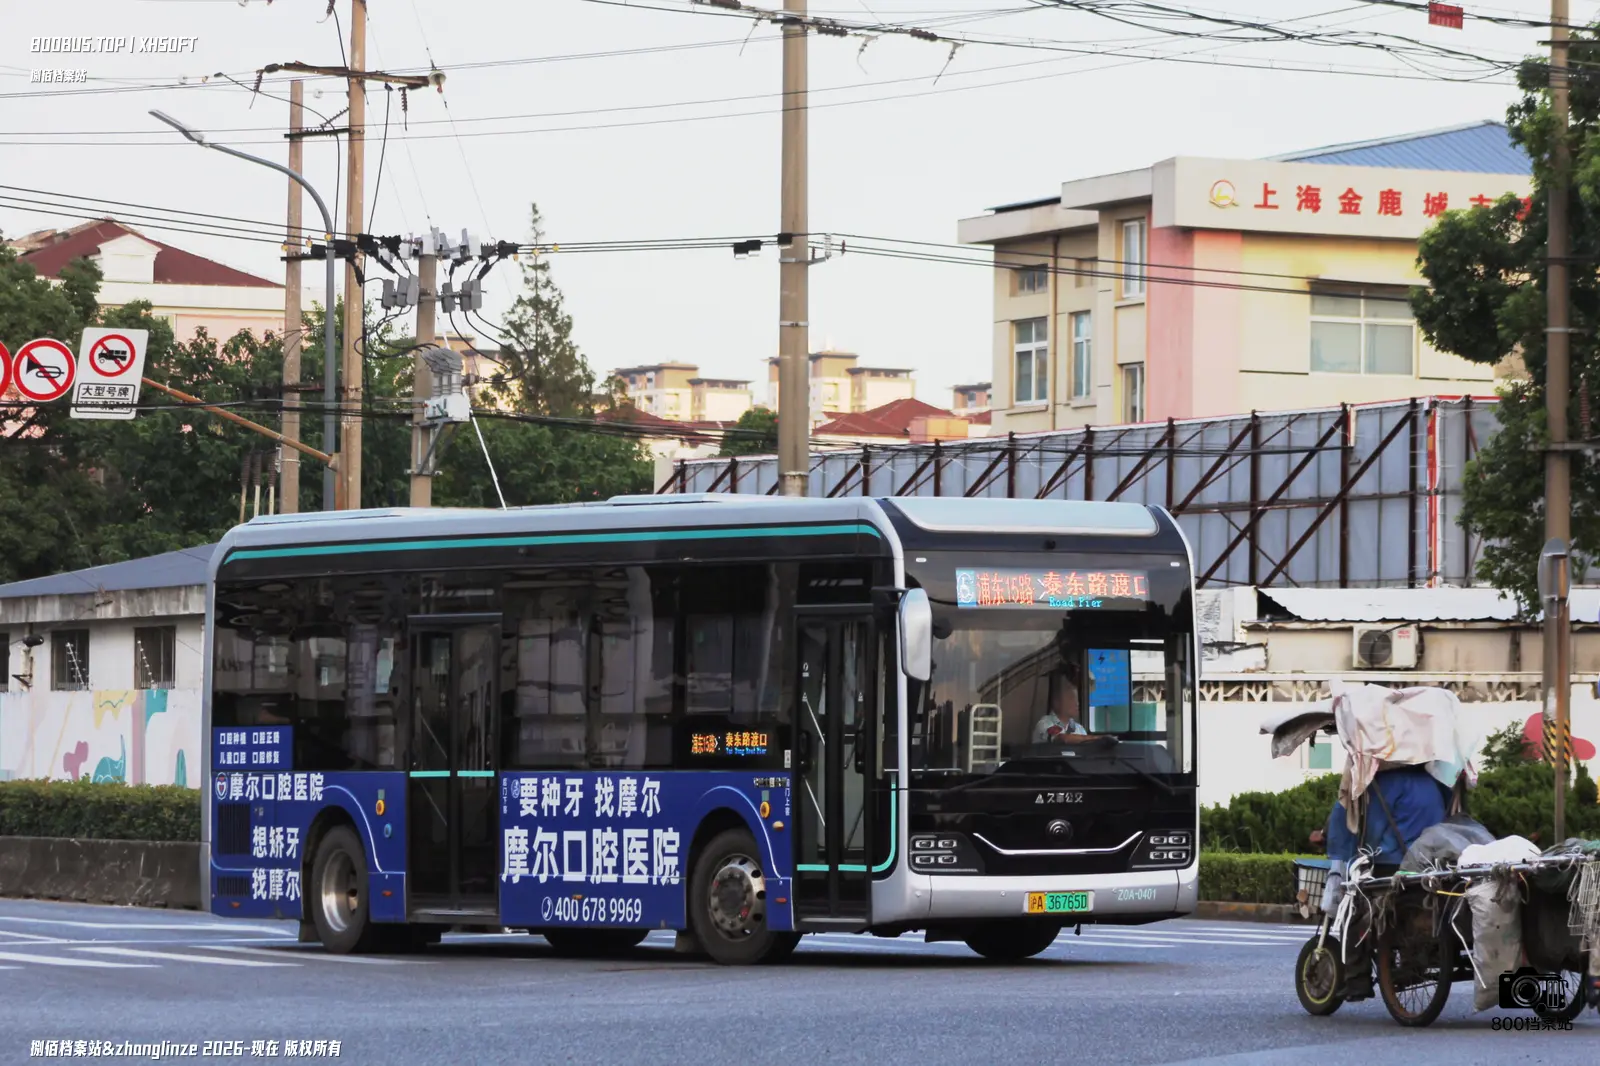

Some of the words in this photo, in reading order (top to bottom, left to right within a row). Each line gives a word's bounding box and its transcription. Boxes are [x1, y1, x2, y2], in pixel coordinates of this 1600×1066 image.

[81, 385, 130, 397] 大型号牌
[976, 572, 1035, 606] 浦东15路
[1049, 597, 1074, 608] Road
[1078, 597, 1103, 608] Pier
[219, 731, 247, 745] 口腔种植
[725, 731, 767, 747] 泰东路渡口
[219, 750, 247, 765] 儿童口腔
[252, 750, 280, 764] 口腔修复
[229, 772, 325, 801] 摩尔口腔医院
[518, 777, 584, 817] 要种牙
[595, 777, 661, 818] 找摩尔
[252, 826, 300, 859] 想矫牙
[501, 826, 680, 886] 摩尔口腔医院
[251, 867, 301, 902] 找摩尔
[555, 897, 579, 922] 400
[582, 897, 606, 922] 678
[610, 898, 642, 923] 9969
[1048, 894, 1088, 911] 36765D
